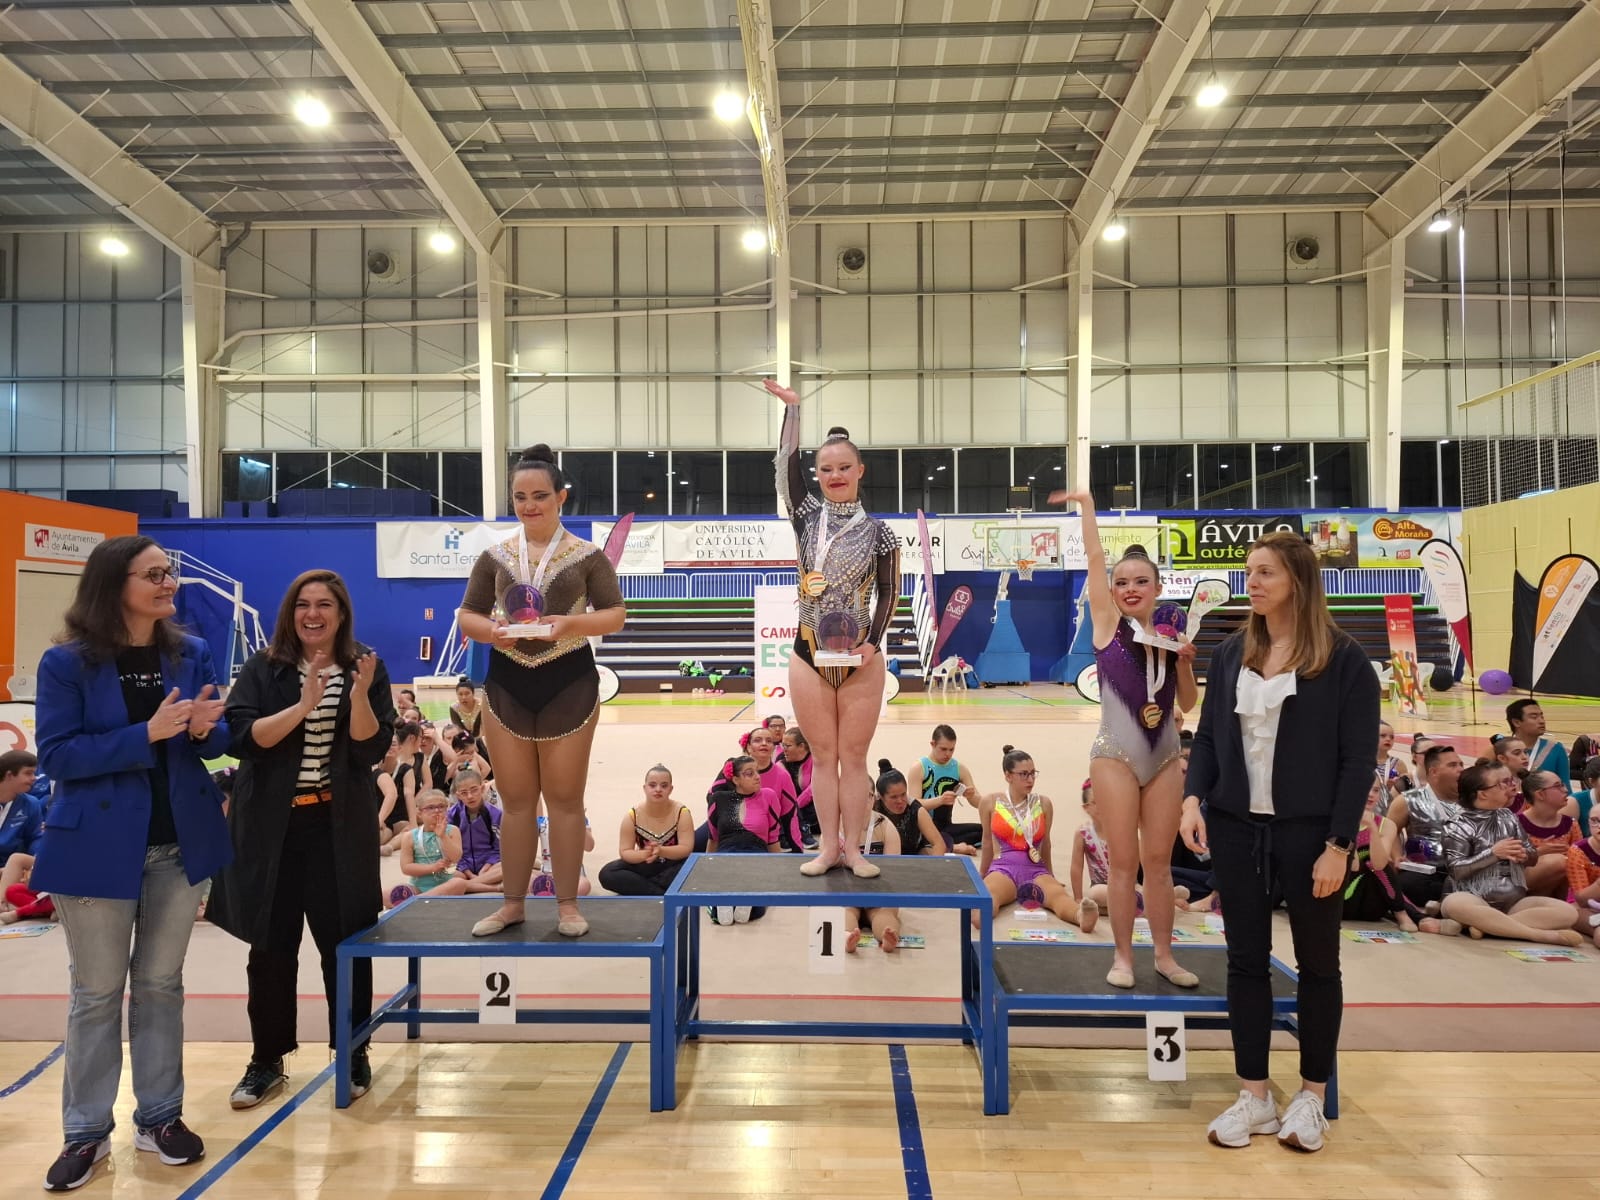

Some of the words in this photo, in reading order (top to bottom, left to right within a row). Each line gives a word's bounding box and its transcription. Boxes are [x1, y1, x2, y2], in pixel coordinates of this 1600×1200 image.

[695, 525, 766, 534] UNIVERSIDAD
[1396, 521, 1416, 530] Alta
[51, 531, 98, 544] Ayuntamiento
[1394, 530, 1430, 538] Moraña
[695, 535, 766, 546] CATÓLICA
[896, 536, 941, 547] EVR
[51, 543, 60, 551] de
[61, 541, 79, 553] Ávila
[1066, 546, 1080, 556] de
[410, 551, 450, 565] Santa
[696, 550, 715, 559] DE
[719, 548, 765, 559] ÁVILA
[817, 921, 835, 956] 1
[485, 972, 511, 1007] 2
[1153, 1026, 1181, 1062] 3
